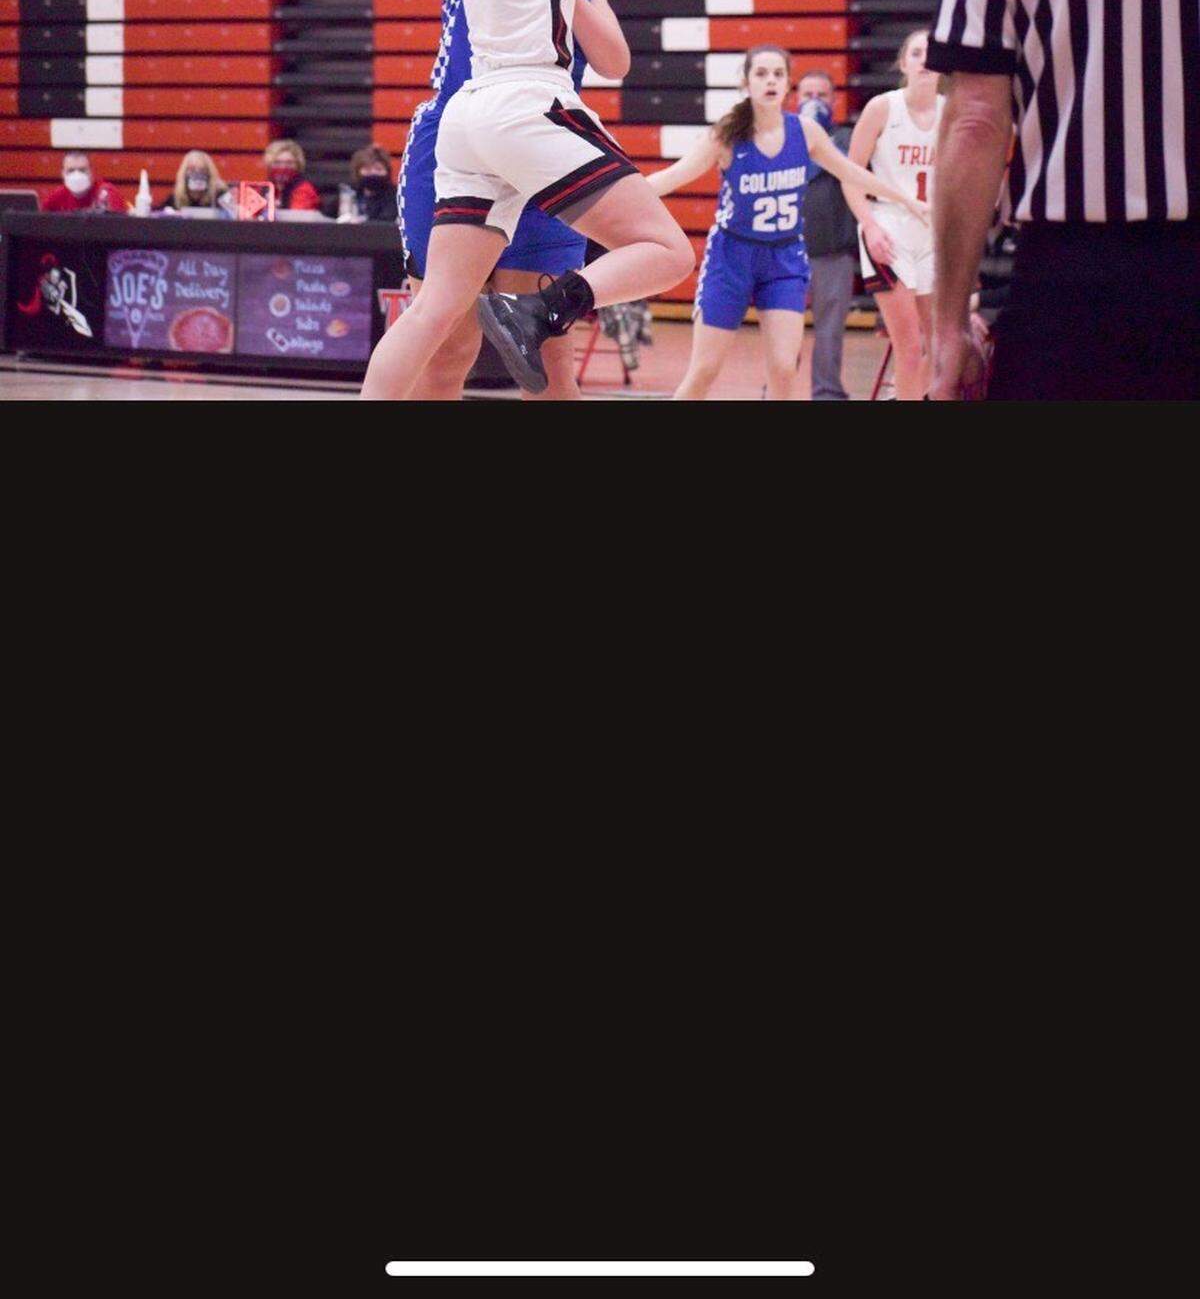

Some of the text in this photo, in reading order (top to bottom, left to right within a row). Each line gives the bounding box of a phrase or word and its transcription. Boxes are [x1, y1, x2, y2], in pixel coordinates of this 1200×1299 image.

[752, 192, 799, 232] 25
[178, 260, 198, 276] All
[203, 261, 228, 286] Day
[110, 271, 168, 310] JOE'S
[175, 282, 229, 308] Delivery
